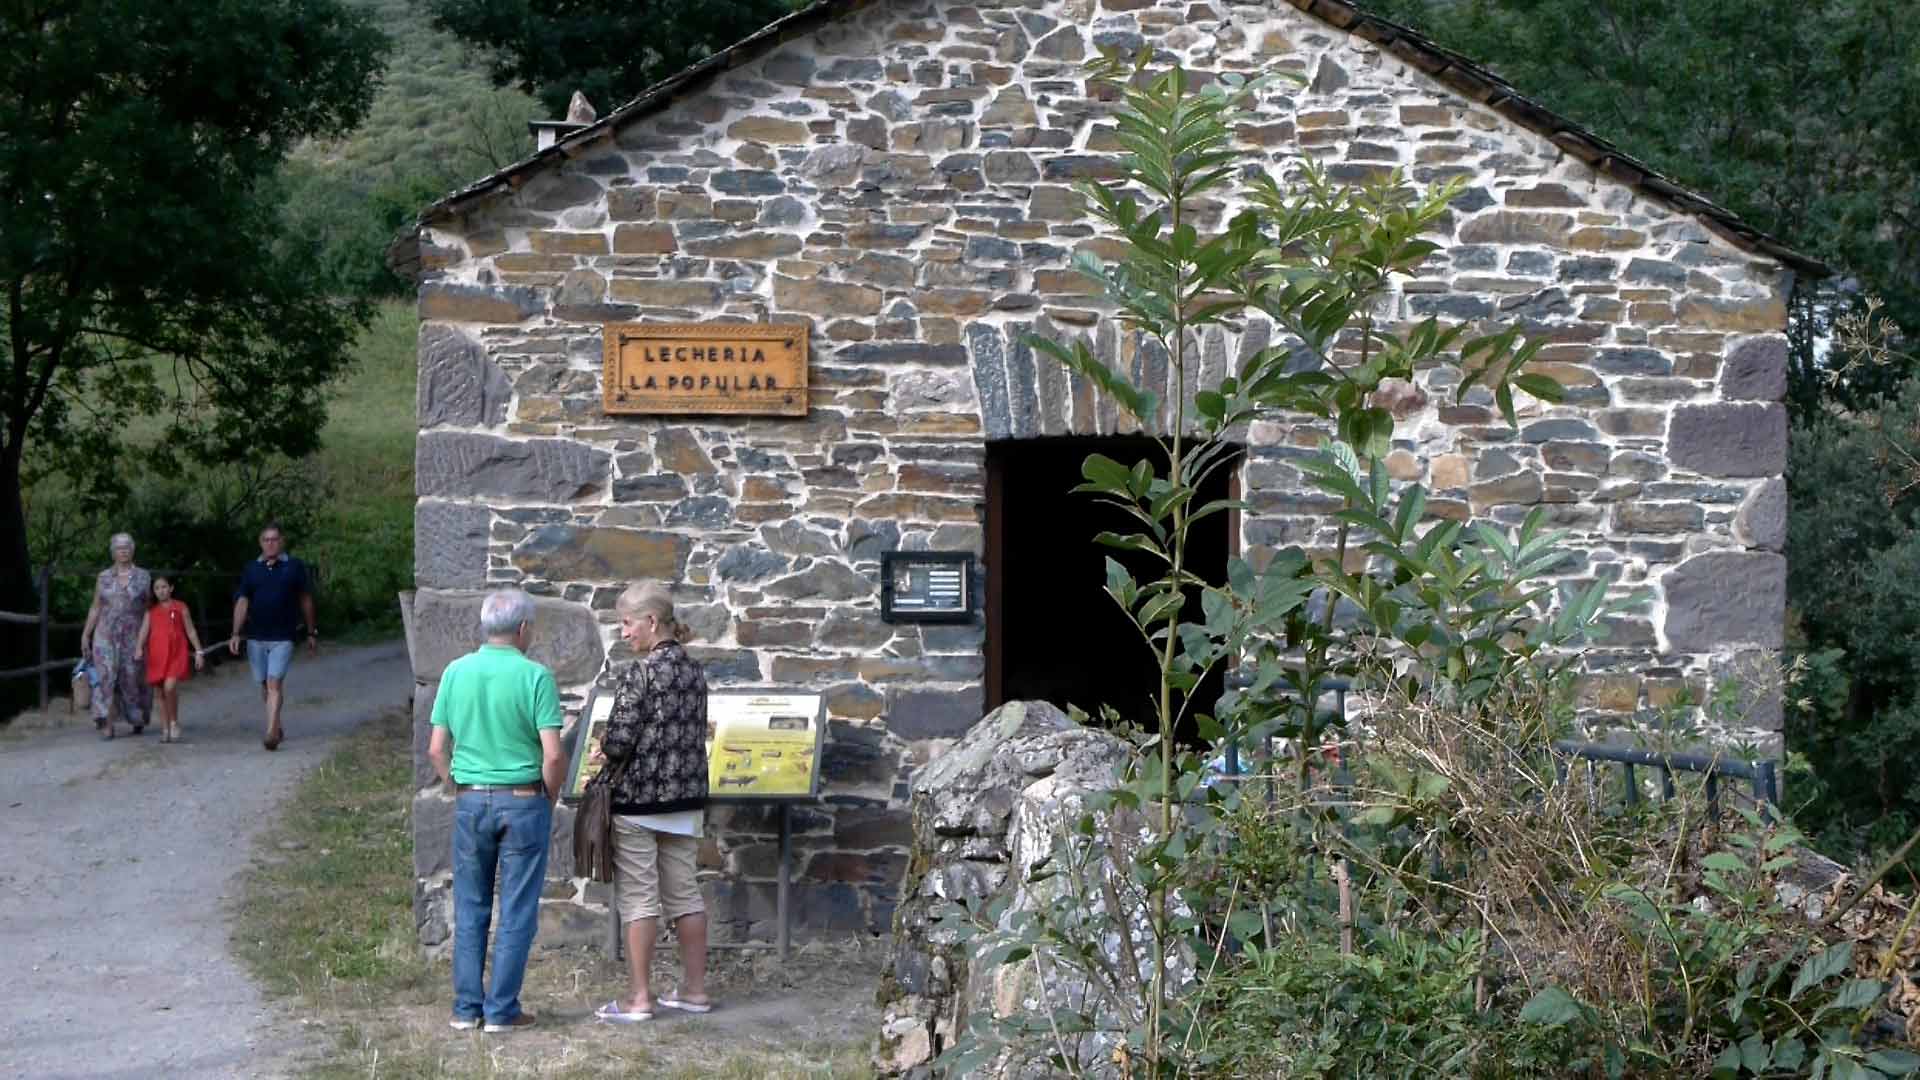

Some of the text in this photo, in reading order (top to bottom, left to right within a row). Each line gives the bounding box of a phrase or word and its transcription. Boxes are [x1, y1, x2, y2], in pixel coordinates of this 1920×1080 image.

[644, 347, 766, 362] LECHERIA
[630, 375, 777, 391] LA POPULAR
